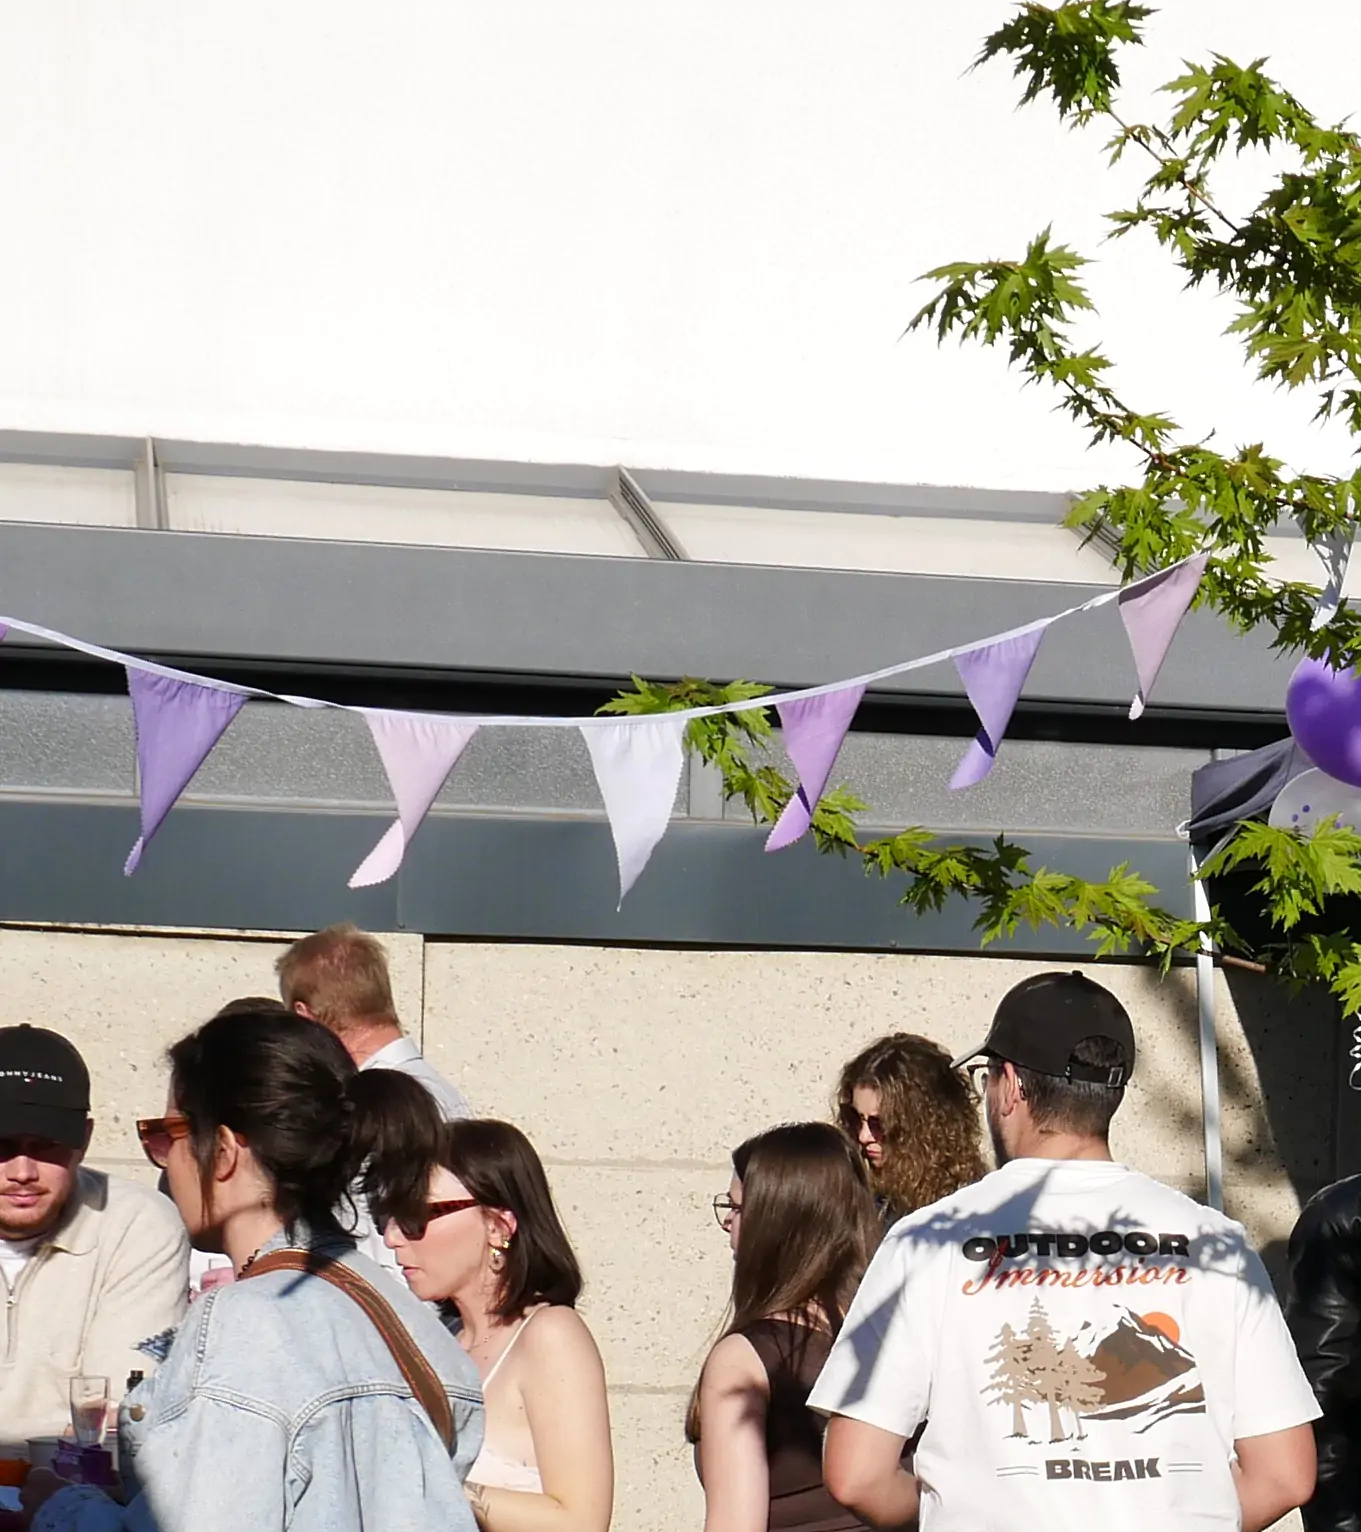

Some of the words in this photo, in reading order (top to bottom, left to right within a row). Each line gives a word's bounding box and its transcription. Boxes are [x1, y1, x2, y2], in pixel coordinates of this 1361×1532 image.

[962, 1232, 1190, 1262] OUTDOOR
[962, 1238, 1192, 1296] Immersion
[1045, 1457, 1162, 1482] BREAK
